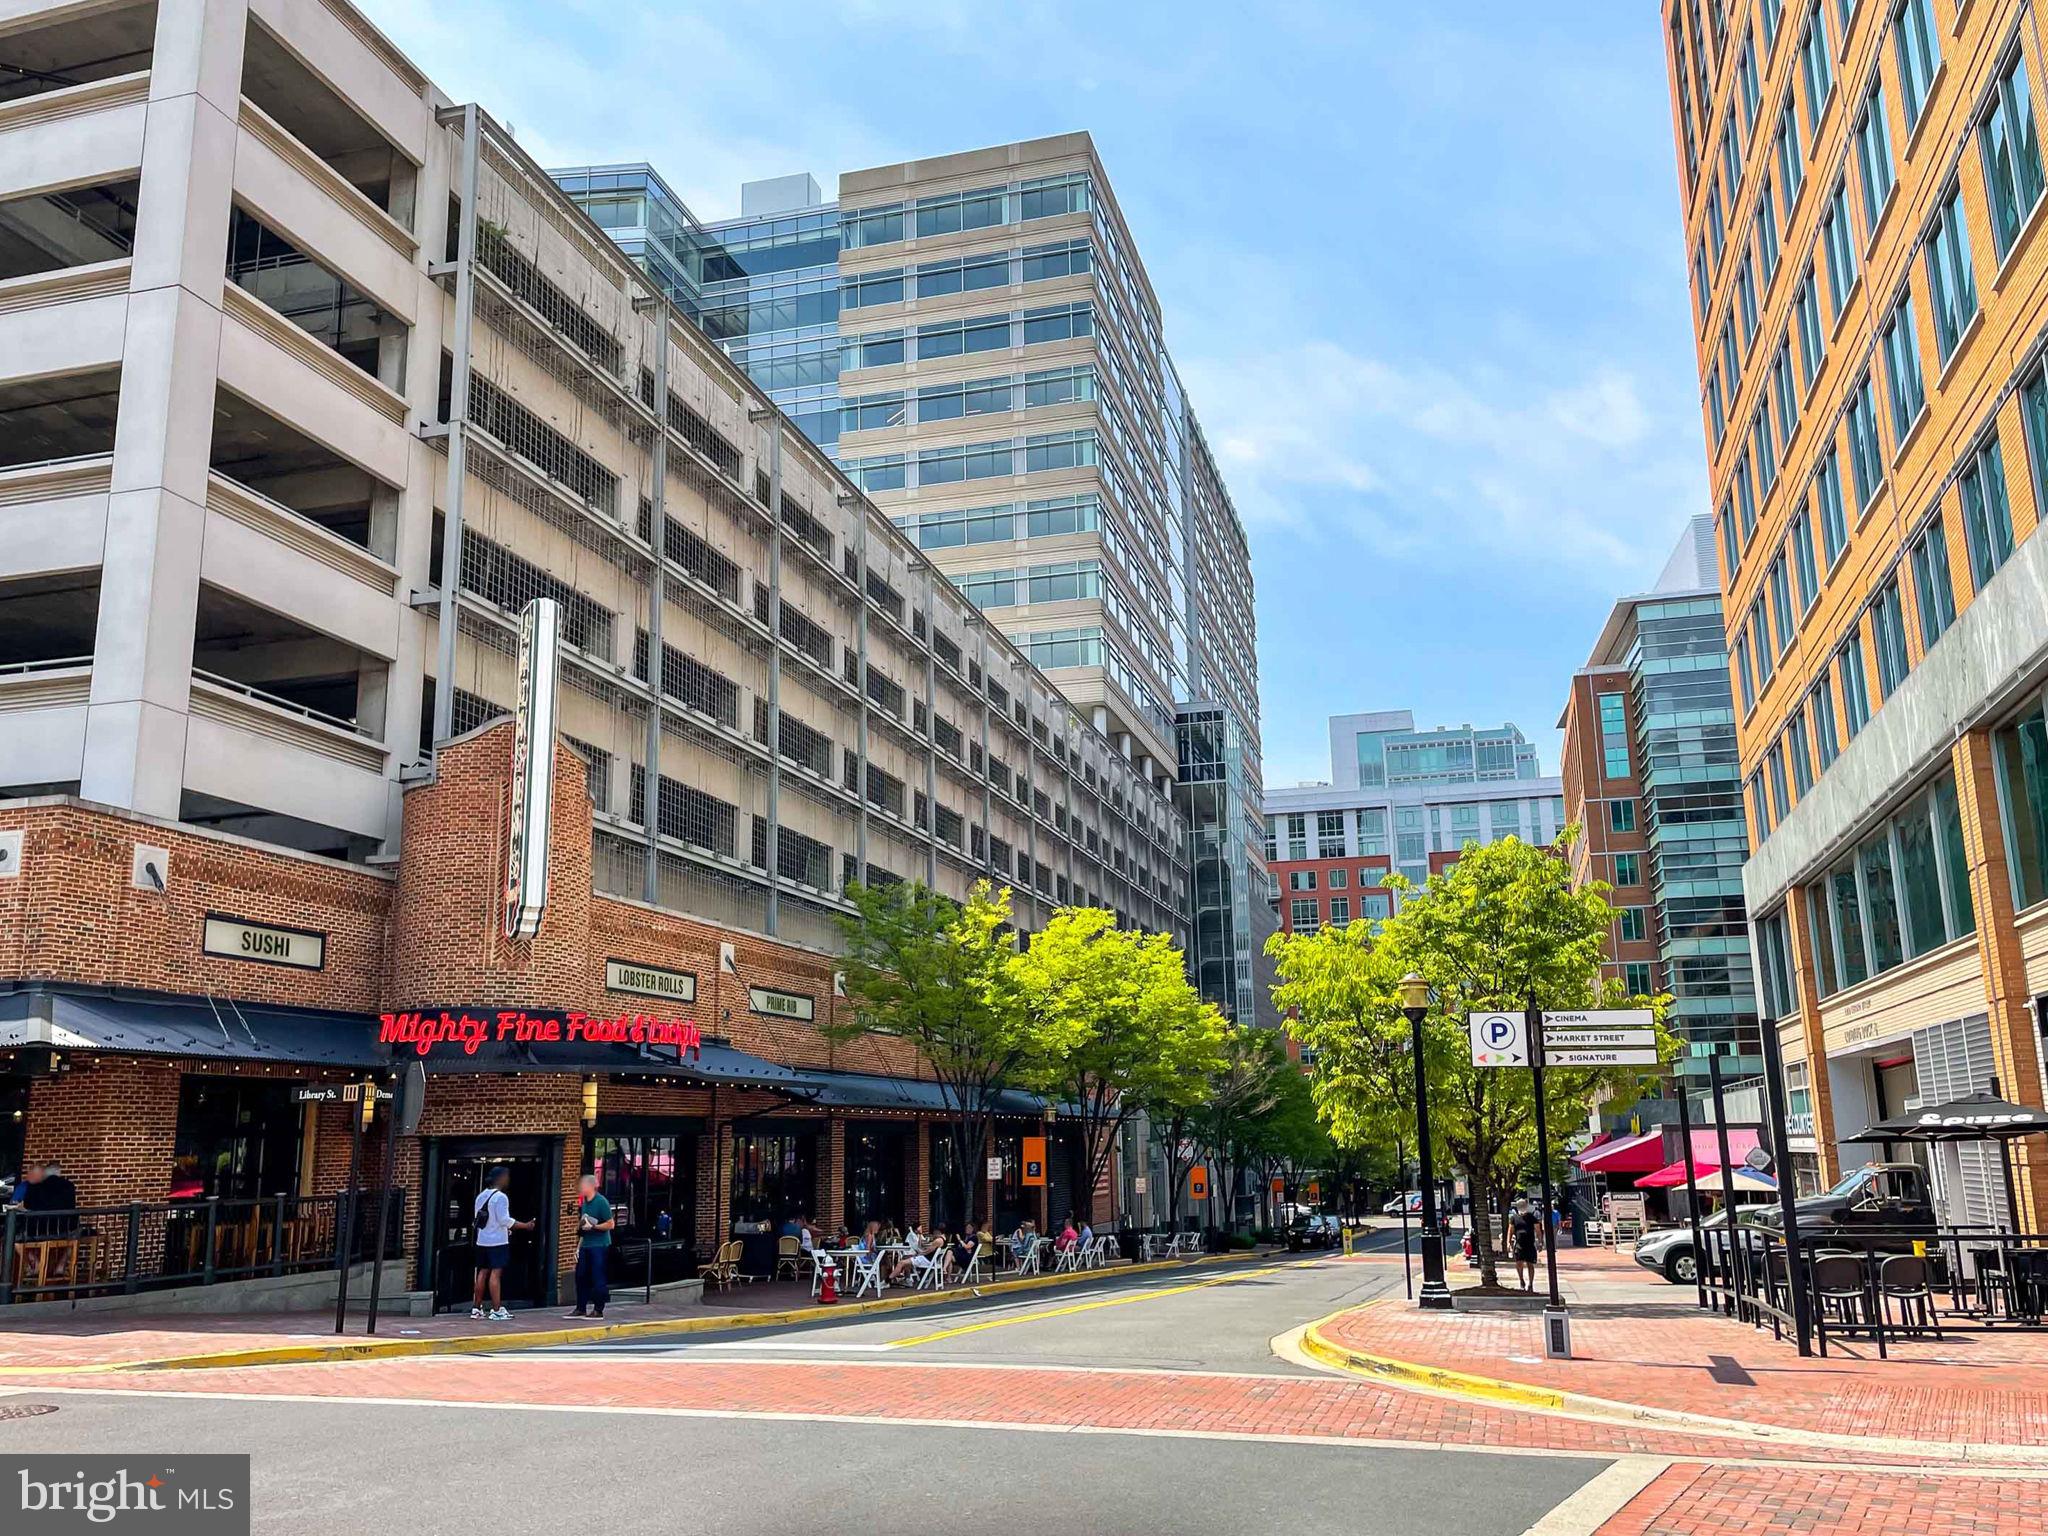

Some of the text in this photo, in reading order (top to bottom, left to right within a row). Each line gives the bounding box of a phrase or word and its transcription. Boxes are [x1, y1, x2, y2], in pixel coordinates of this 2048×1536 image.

[241, 931, 291, 957] SUSHI
[618, 968, 684, 995] LOBSTER ROLLS
[766, 995, 786, 1012] PRIME
[1554, 1014, 1588, 1023] CINEMA
[380, 1012, 488, 1055] Mighty
[496, 1012, 561, 1042] Fine
[566, 1012, 629, 1042] Food
[630, 1013, 646, 1043] &
[1490, 1022, 1508, 1044] P
[1556, 1034, 1625, 1042] MARKET STREET
[1568, 1054, 1618, 1062] SIGNATURE
[298, 1088, 326, 1101] Library
